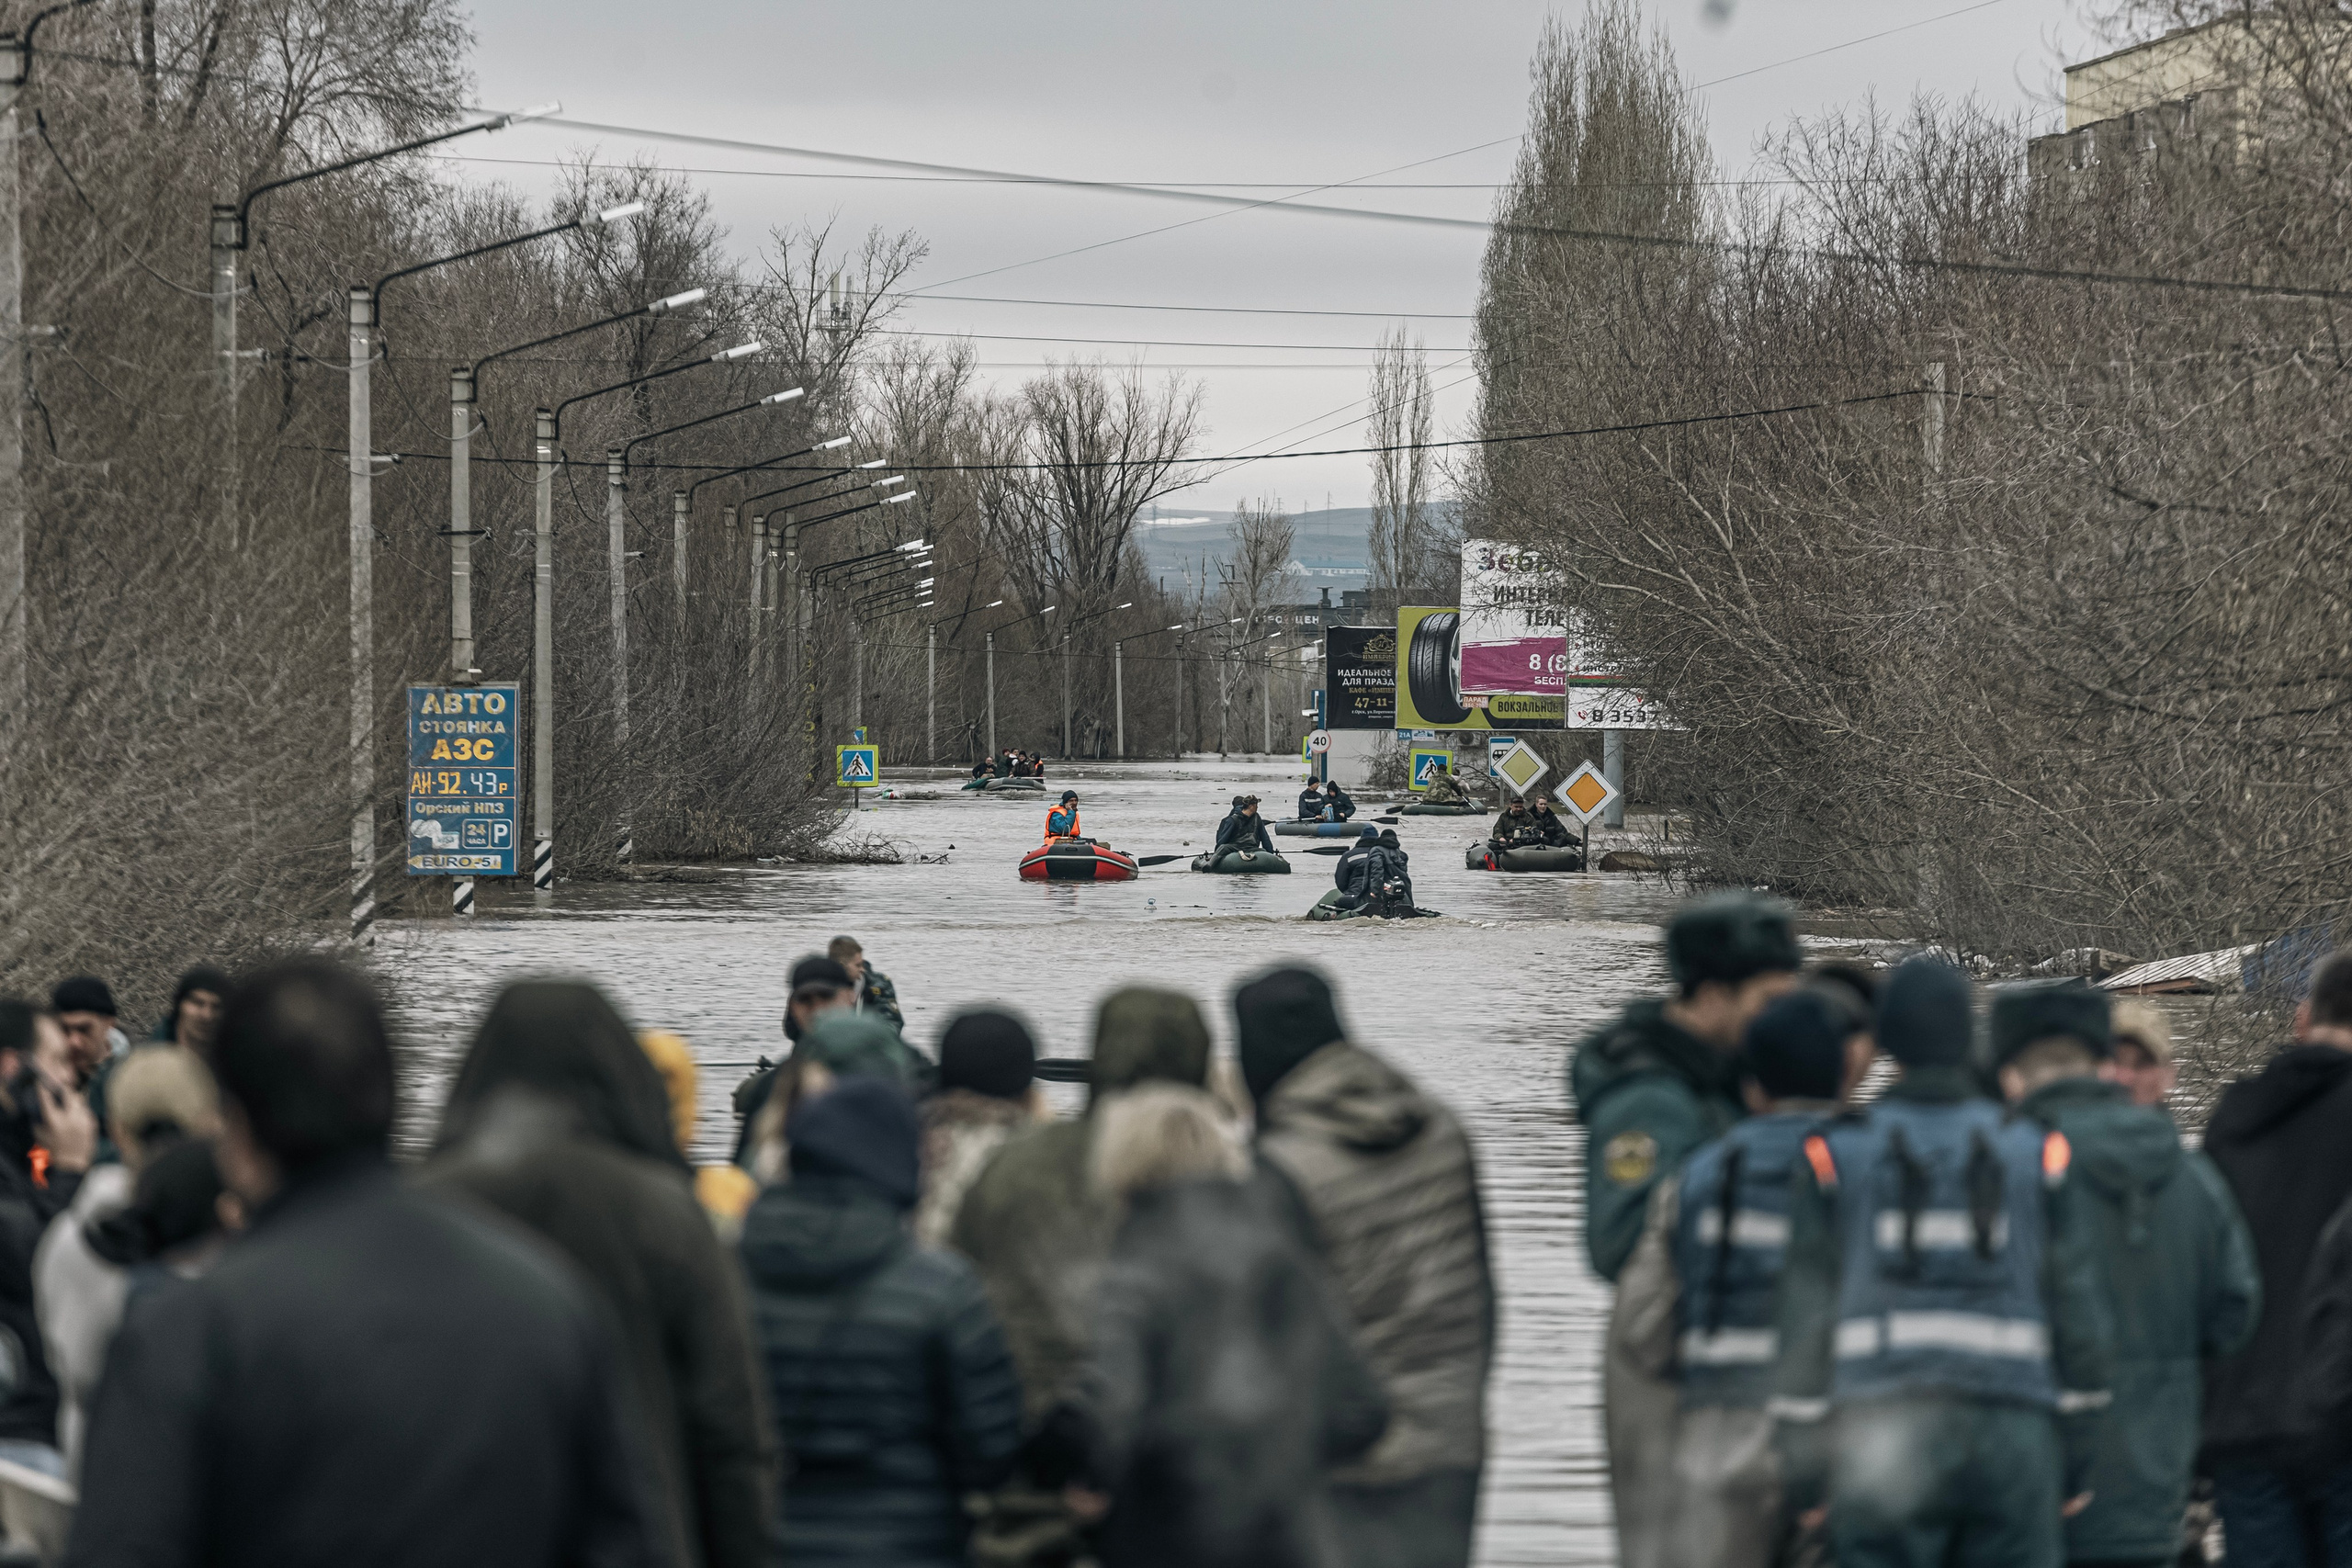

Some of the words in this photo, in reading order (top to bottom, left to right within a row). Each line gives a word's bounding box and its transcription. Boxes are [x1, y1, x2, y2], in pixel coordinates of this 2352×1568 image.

[1529, 653, 1542, 671] 8
[1337, 669, 1392, 677] ИДЕАЛЬНОЕ
[1341, 678, 1362, 686] ДЛЯ
[1364, 678, 1396, 686] ПРАЗД
[1533, 676, 1566, 686] БЕСП
[420, 693, 506, 715] АВТО
[1498, 701, 1559, 713] ВОКЗАЛЬНОЕ
[1592, 709, 1603, 722] 8
[419, 720, 506, 734] СТОЯНКА
[1312, 736, 1328, 746] 40
[430, 738, 495, 761] АЗС
[415, 801, 470, 816] Орский
[474, 802, 505, 814] НПЗ
[467, 824, 487, 836] 24
[467, 837, 487, 845] ЧАСА
[422, 856, 492, 867] EURO-5
